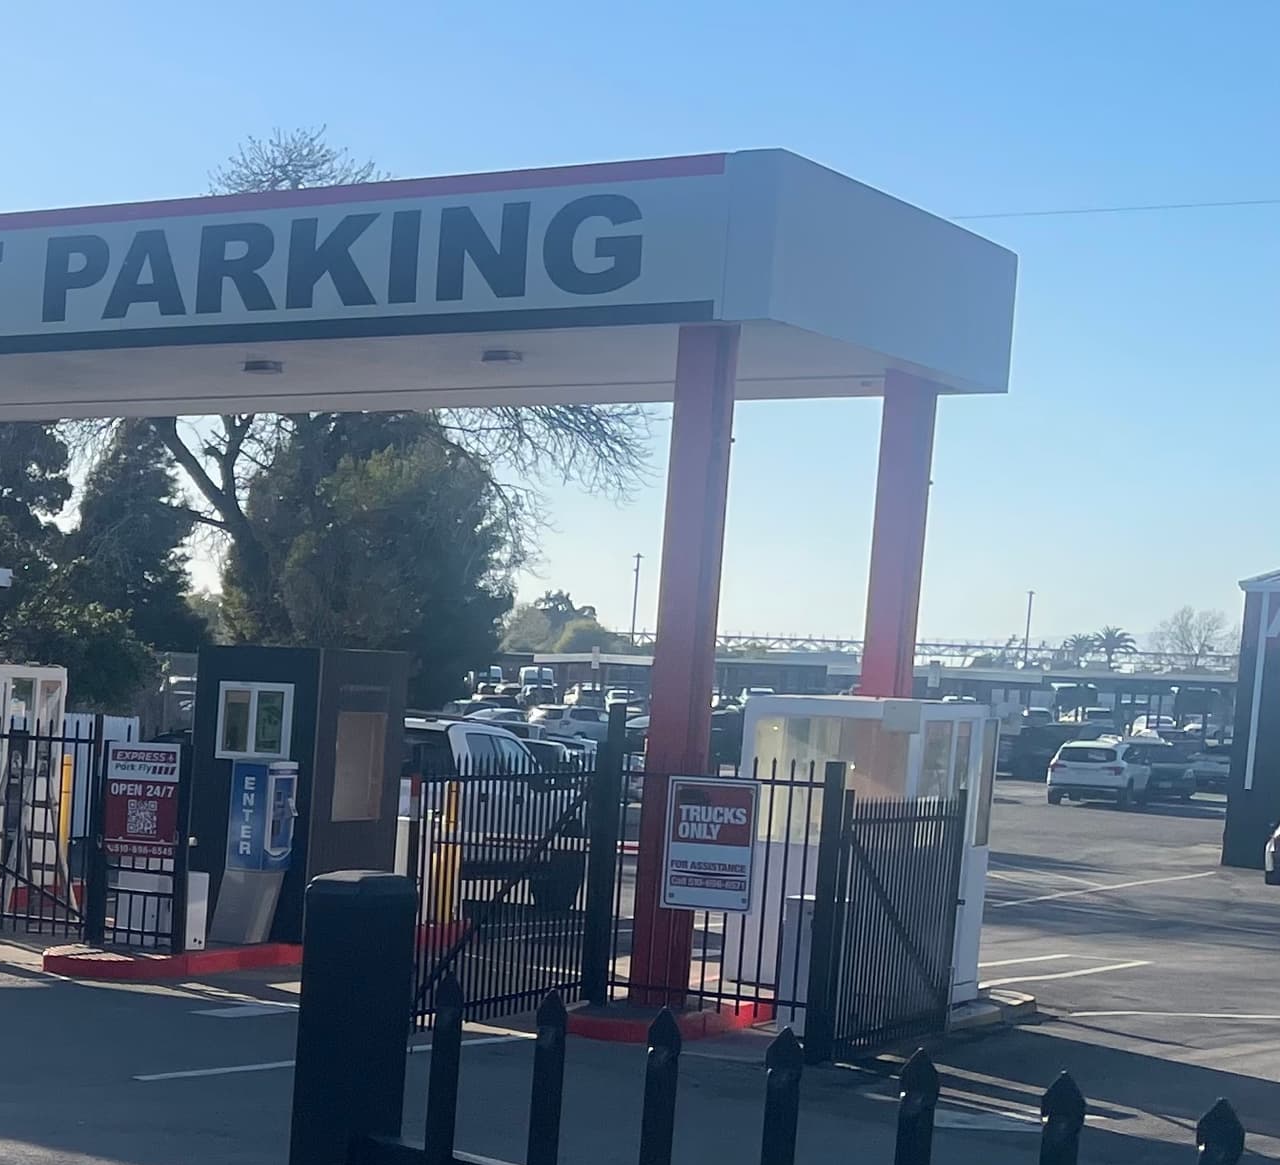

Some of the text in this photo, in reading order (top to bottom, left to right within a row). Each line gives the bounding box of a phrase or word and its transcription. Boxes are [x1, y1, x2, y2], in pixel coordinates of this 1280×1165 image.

[42, 194, 643, 324] PARKING
[116, 751, 167, 762] EXPRESS
[115, 762, 152, 775] Park Fly
[110, 782, 175, 798] OPEN 24/7
[239, 776, 256, 855] ENTER
[679, 804, 747, 825] TRUCKS
[678, 821, 721, 841] ONLY
[671, 859, 747, 873] FOR ASSISTANCE
